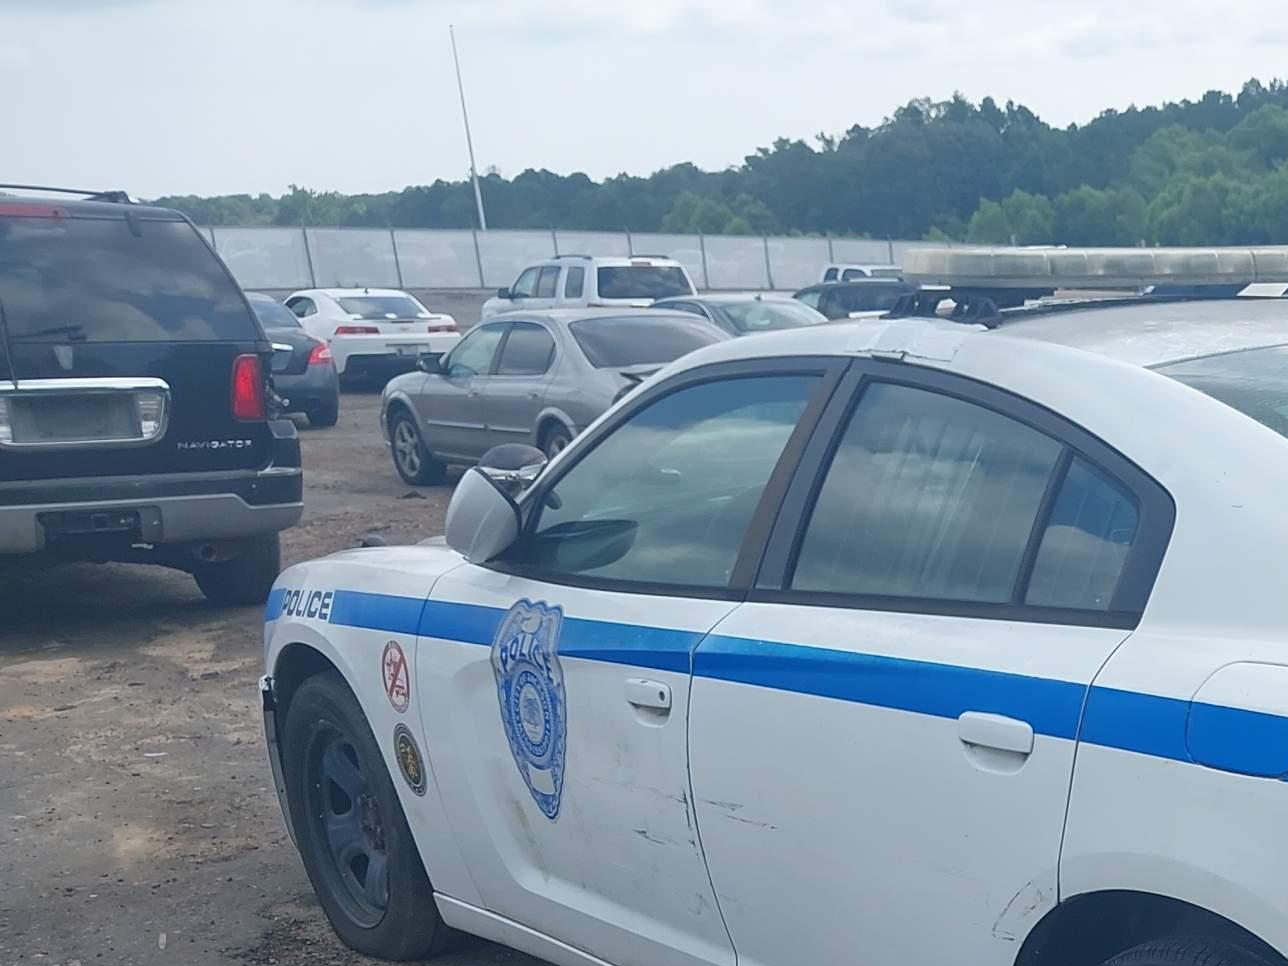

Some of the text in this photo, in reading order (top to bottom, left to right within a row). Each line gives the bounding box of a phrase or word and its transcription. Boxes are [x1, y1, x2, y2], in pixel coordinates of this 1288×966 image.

[177, 439, 253, 449] NAVIGATOR
[283, 590, 333, 620] POLICE
[499, 634, 554, 684] POLICE
